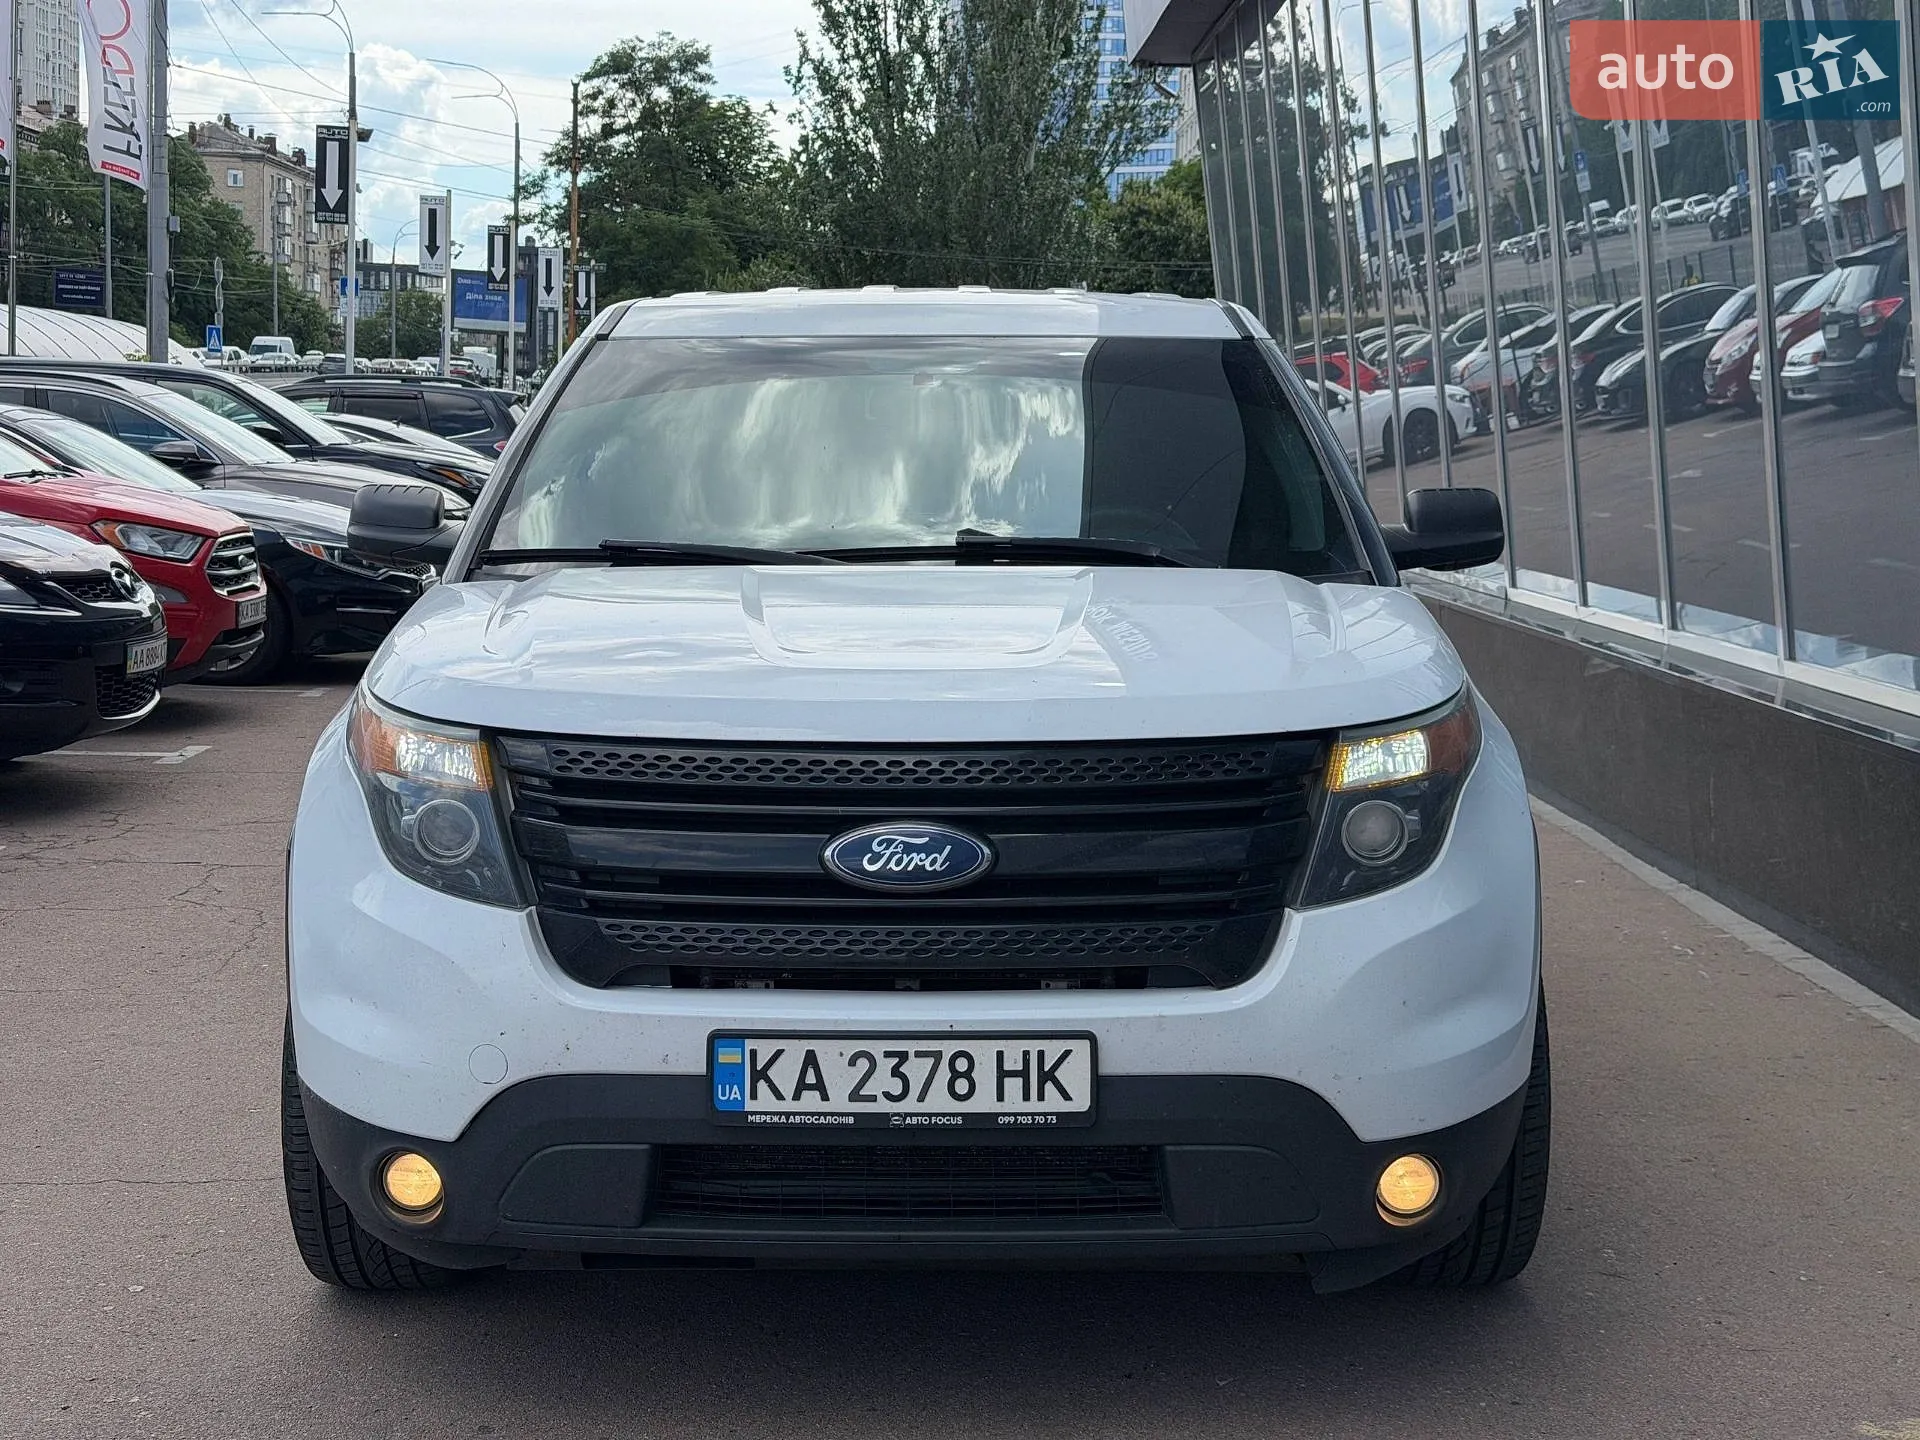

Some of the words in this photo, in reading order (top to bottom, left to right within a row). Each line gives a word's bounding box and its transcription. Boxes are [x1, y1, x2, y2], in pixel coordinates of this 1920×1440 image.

[862, 835, 952, 872] Ford
[749, 1048, 830, 1102] KA
[847, 1050, 977, 1103] 2378
[996, 1049, 1074, 1102] HK
[718, 1085, 741, 1101] UA
[747, 1114, 787, 1123] МЕРЕЖА
[788, 1115, 855, 1124] АВТОСАЛОНІВ
[931, 1116, 963, 1125] FOCUS
[998, 1115, 1015, 1124] 099
[1016, 1115, 1033, 1124] 703
[1033, 1115, 1045, 1124] 70
[1045, 1115, 1057, 1124] 73
